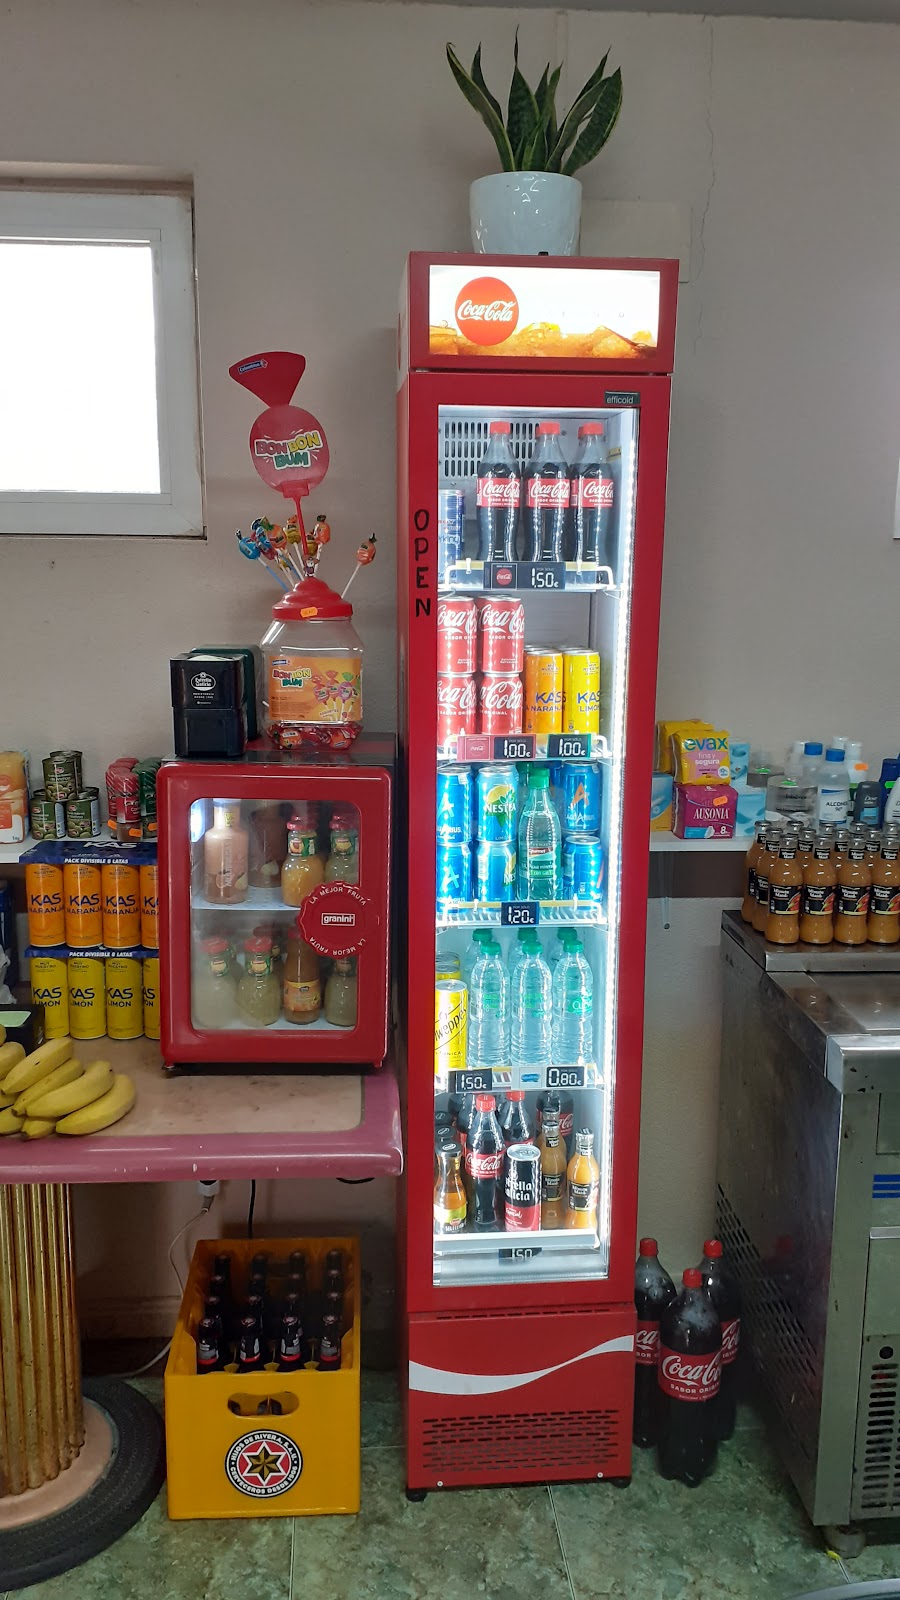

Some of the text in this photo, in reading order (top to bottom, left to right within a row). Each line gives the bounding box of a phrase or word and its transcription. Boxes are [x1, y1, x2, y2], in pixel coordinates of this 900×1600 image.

[457, 300, 516, 322] Coca-Cola
[606, 395, 635, 404] efficold
[255, 432, 321, 455] BON BON
[274, 451, 310, 468] BUM
[413, 508, 431, 618] OPEN
[684, 737, 729, 751] evax
[694, 758, 720, 767] segura
[693, 807, 730, 820] AUSONIA
[720, 826, 727, 834] 8
[83, 841, 137, 849] KAS
[31, 892, 62, 906] KAS
[69, 893, 100, 907] KAS
[106, 894, 136, 907] KAS
[309, 887, 366, 906] LA MEJOR FRUTA
[323, 915, 353, 924] granini
[309, 936, 329, 954] FRUTA
[332, 946, 357, 956] MEJOR
[33, 987, 62, 1000] KAS
[69, 987, 96, 1000] KAS
[107, 987, 134, 1000] KAS
[143, 988, 156, 1000] AS
[670, 1383, 696, 1394] SABOR
[230, 1441, 246, 1461] HIJOS
[243, 1436, 254, 1445] DE
[230, 1466, 266, 1494] CERVECEROS
[266, 1480, 289, 1494] DESDE
